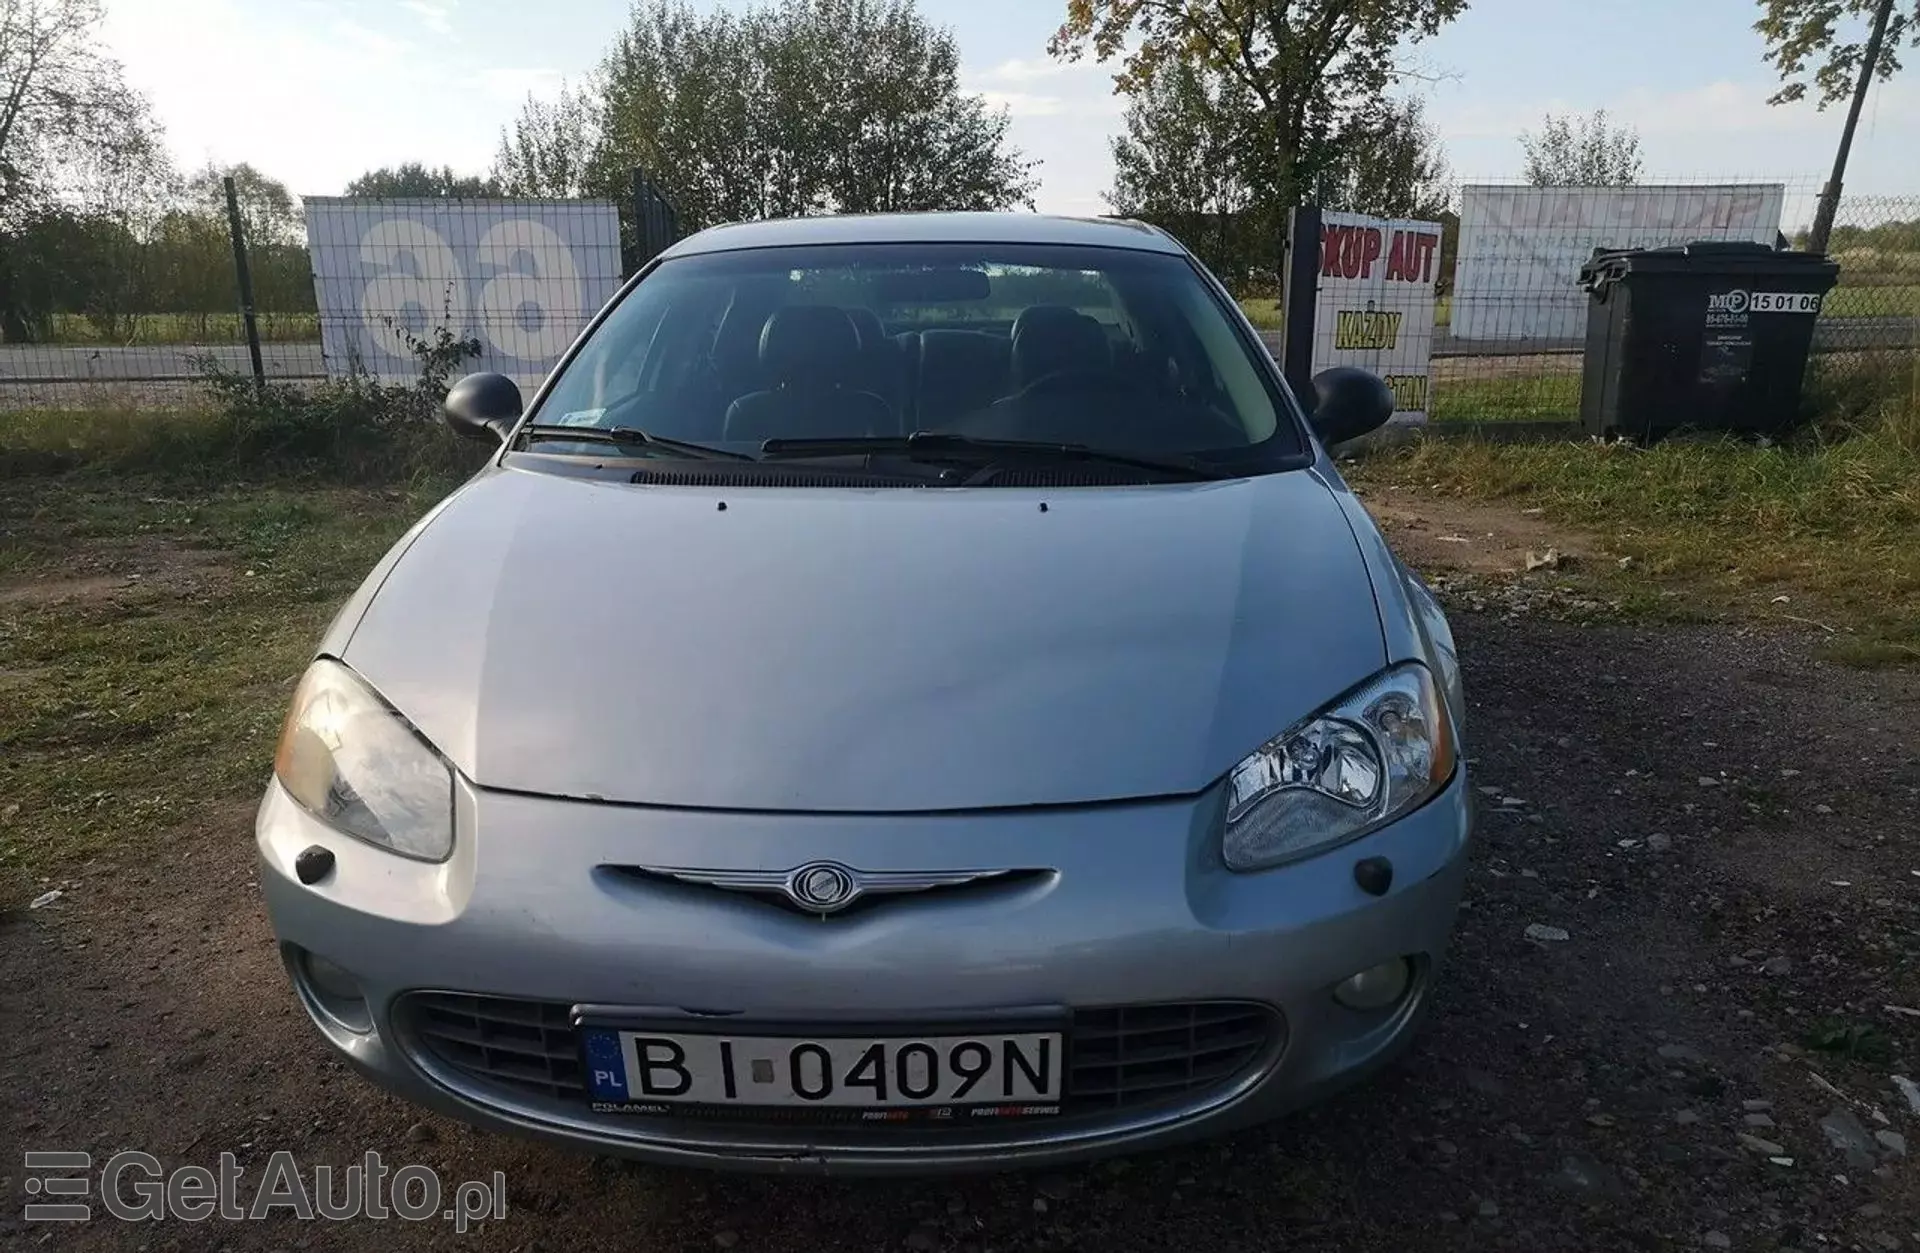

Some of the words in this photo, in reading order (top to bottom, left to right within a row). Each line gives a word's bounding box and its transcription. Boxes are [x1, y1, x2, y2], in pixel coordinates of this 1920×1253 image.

[1320, 223, 1382, 280] KUP
[1385, 229, 1438, 283] AUT
[1752, 295, 1770, 310] 15
[1775, 295, 1794, 310] 01
[1800, 296, 1819, 311] 06
[594, 1069, 622, 1087] PL
[789, 1038, 1050, 1101] 0409N
